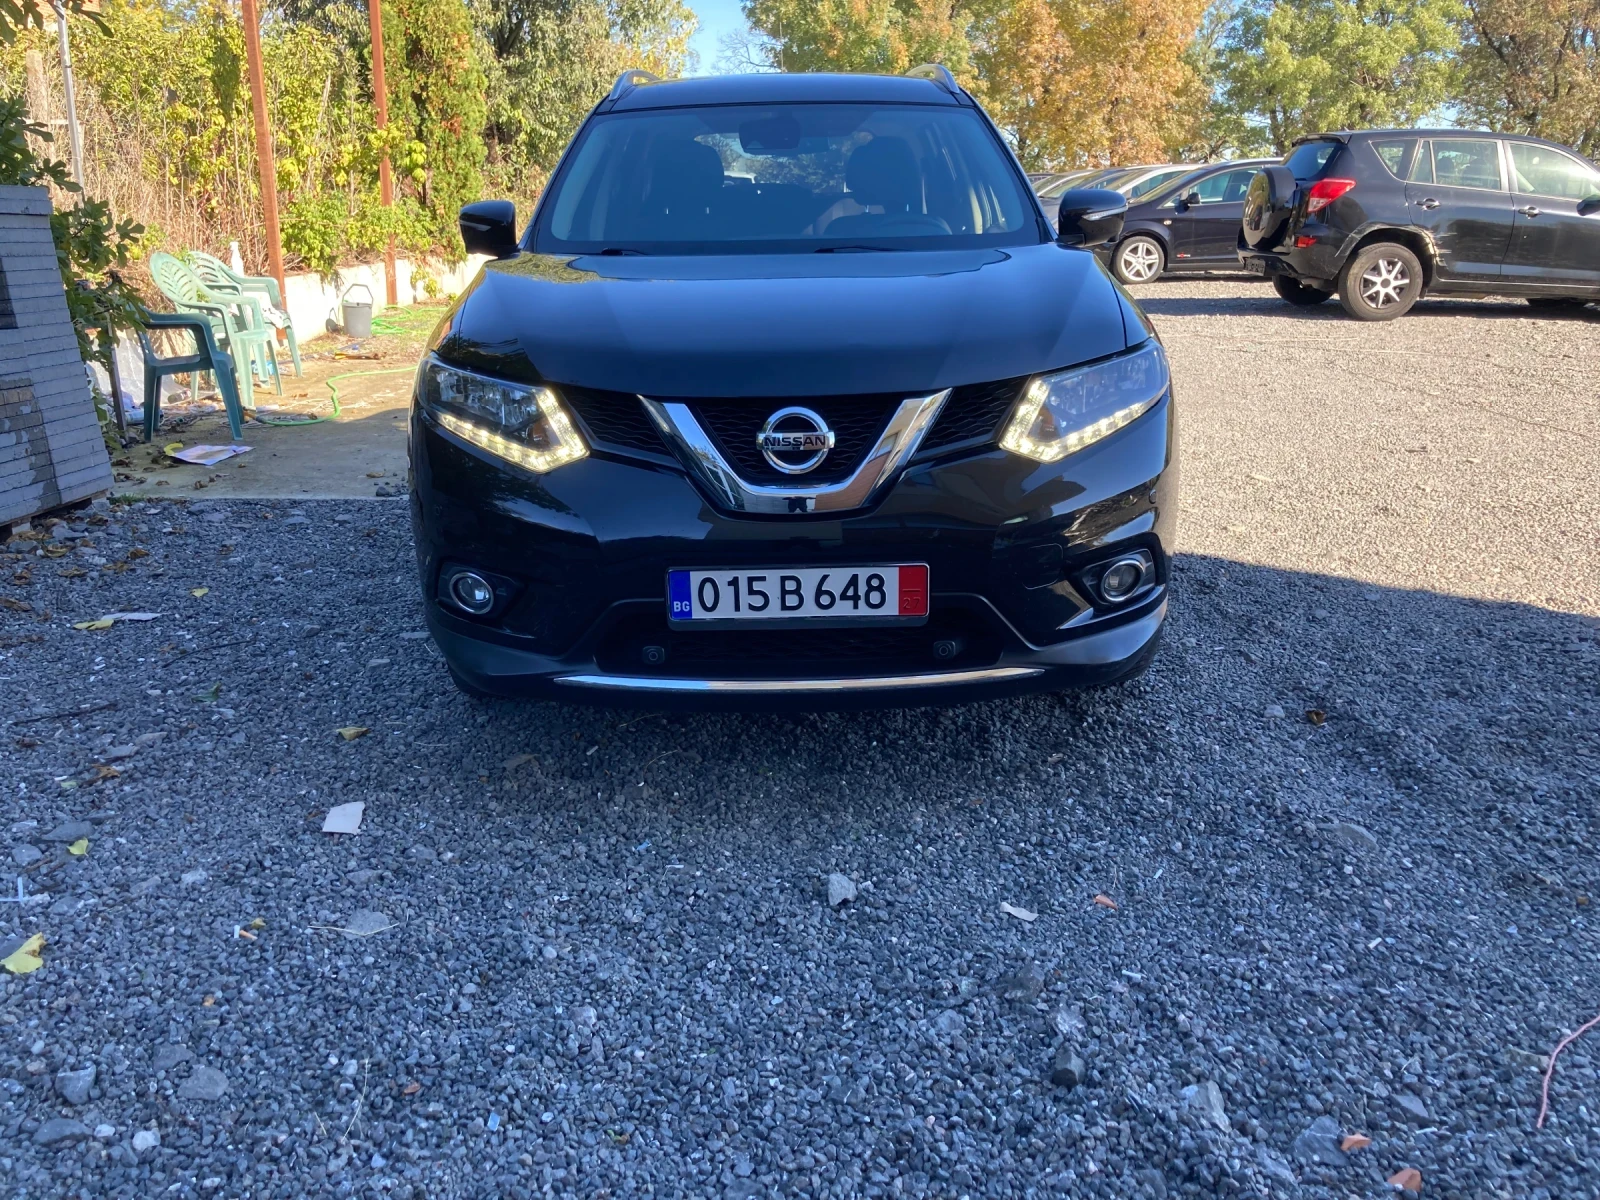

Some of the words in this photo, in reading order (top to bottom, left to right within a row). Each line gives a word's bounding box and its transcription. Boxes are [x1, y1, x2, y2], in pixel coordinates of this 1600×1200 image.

[764, 436, 826, 446] NISSAN
[673, 601, 691, 612] BG
[903, 597, 921, 610] 27
